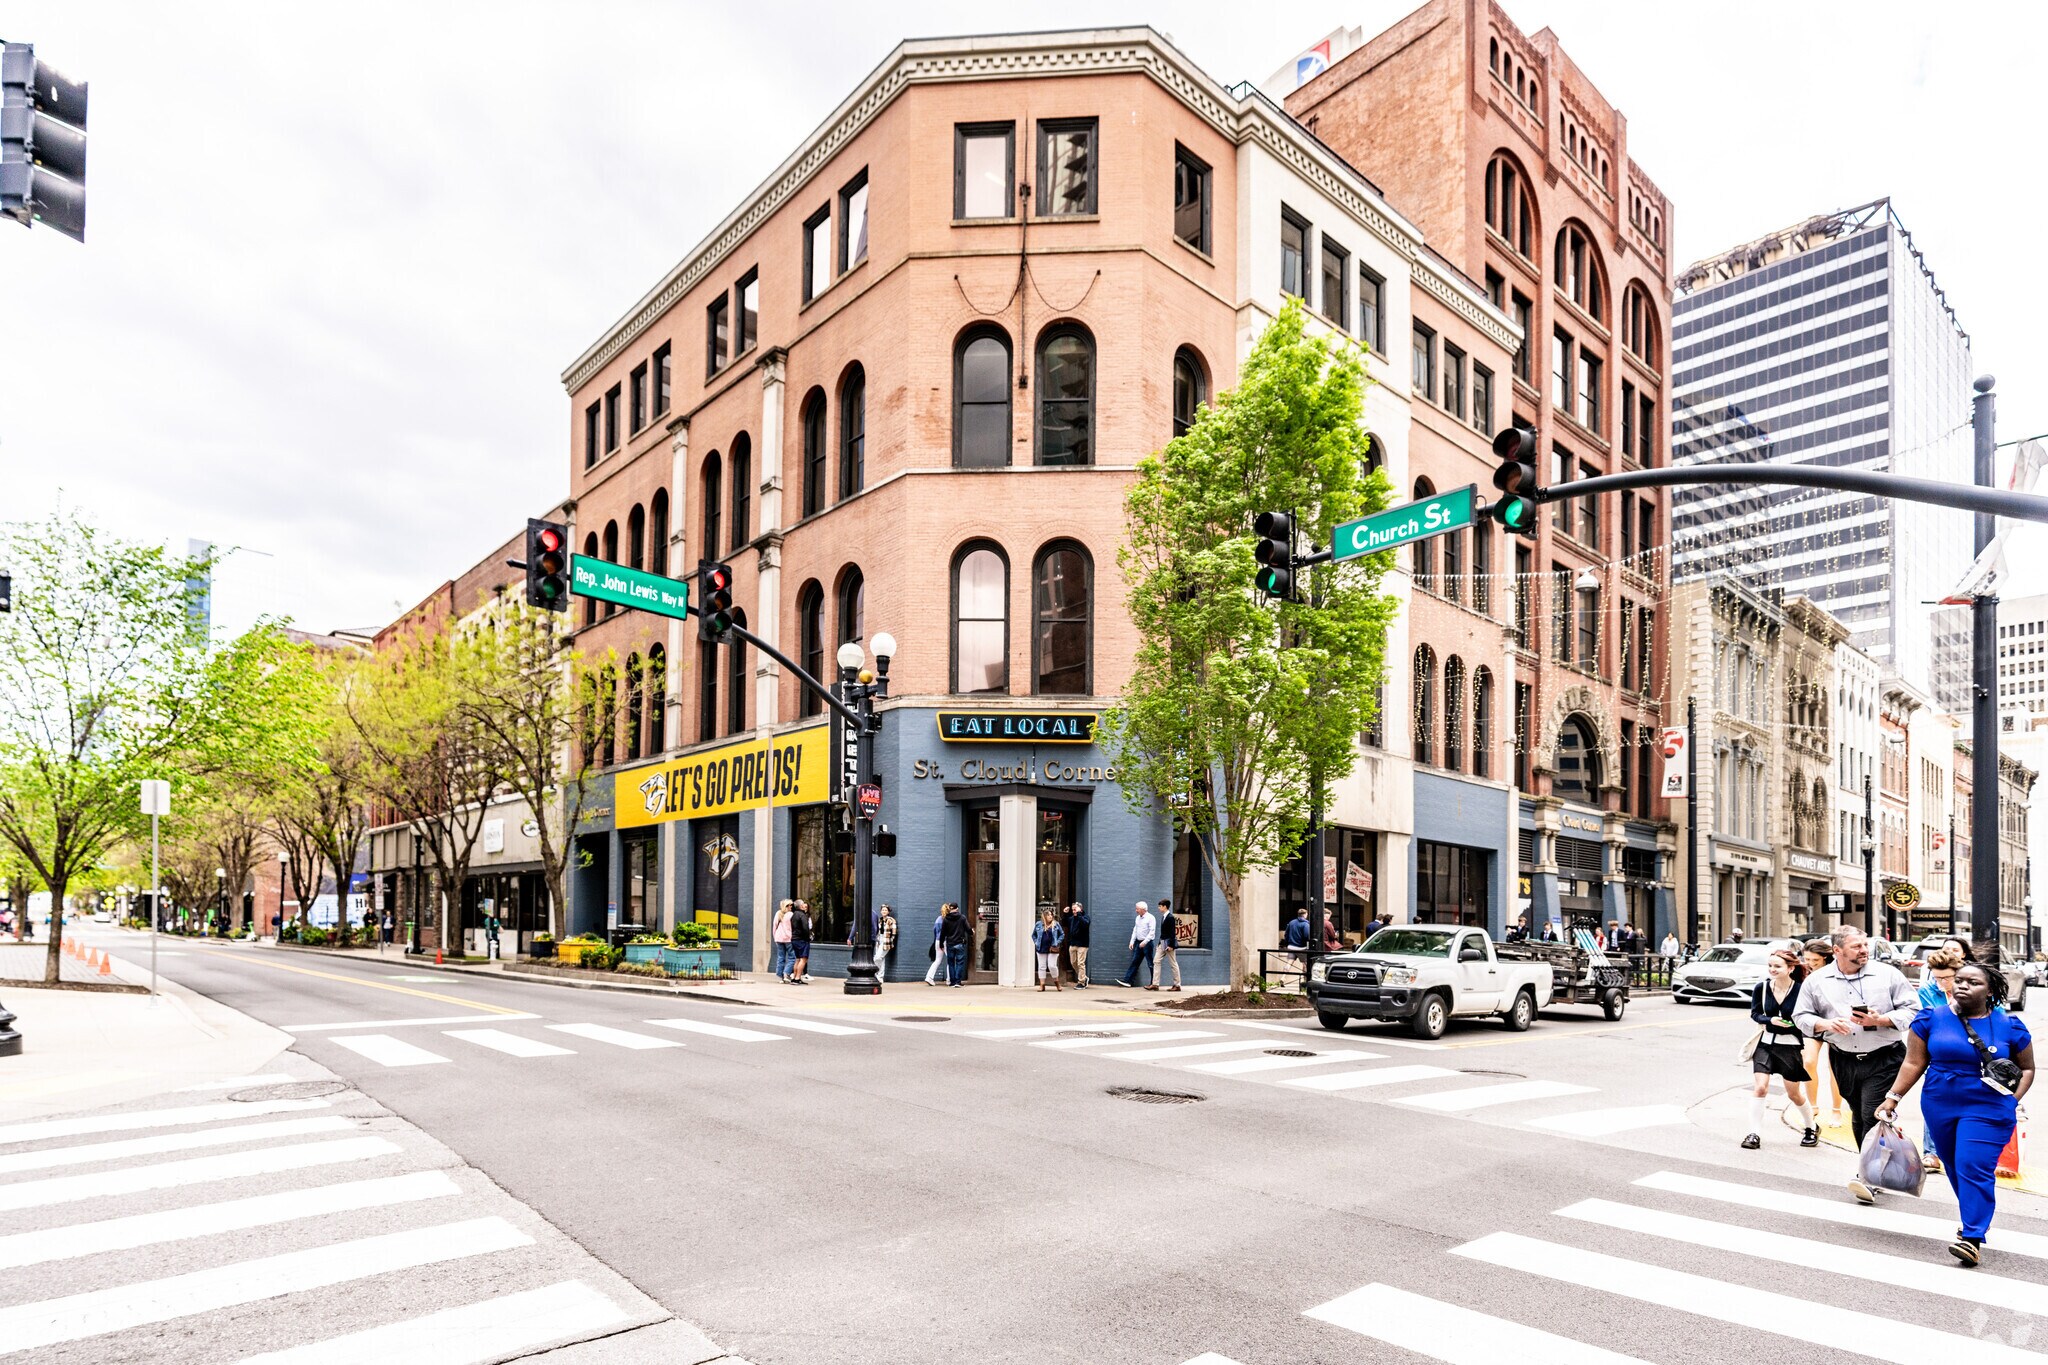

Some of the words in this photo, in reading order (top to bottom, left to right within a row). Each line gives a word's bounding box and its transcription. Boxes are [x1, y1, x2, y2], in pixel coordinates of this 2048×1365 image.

[352, 518, 419, 549] Church
[423, 502, 451, 529] St
[575, 566, 598, 588] Rep.
[600, 573, 627, 593] John
[630, 580, 658, 601] Lewis
[661, 591, 677, 608] Way
[678, 595, 684, 607] N
[950, 717, 996, 735] EAT
[1003, 717, 1084, 736] LOCAL
[665, 764, 702, 813] LET'S
[706, 758, 728, 807] GO
[730, 744, 802, 803] PREDS!
[913, 759, 945, 779] St.
[960, 759, 1028, 780] Cloud
[1043, 760, 1119, 781] Corne
[862, 787, 880, 798] LIVE
[1791, 853, 1817, 870] CHAUVET
[1817, 860, 1831, 873] ARTS
